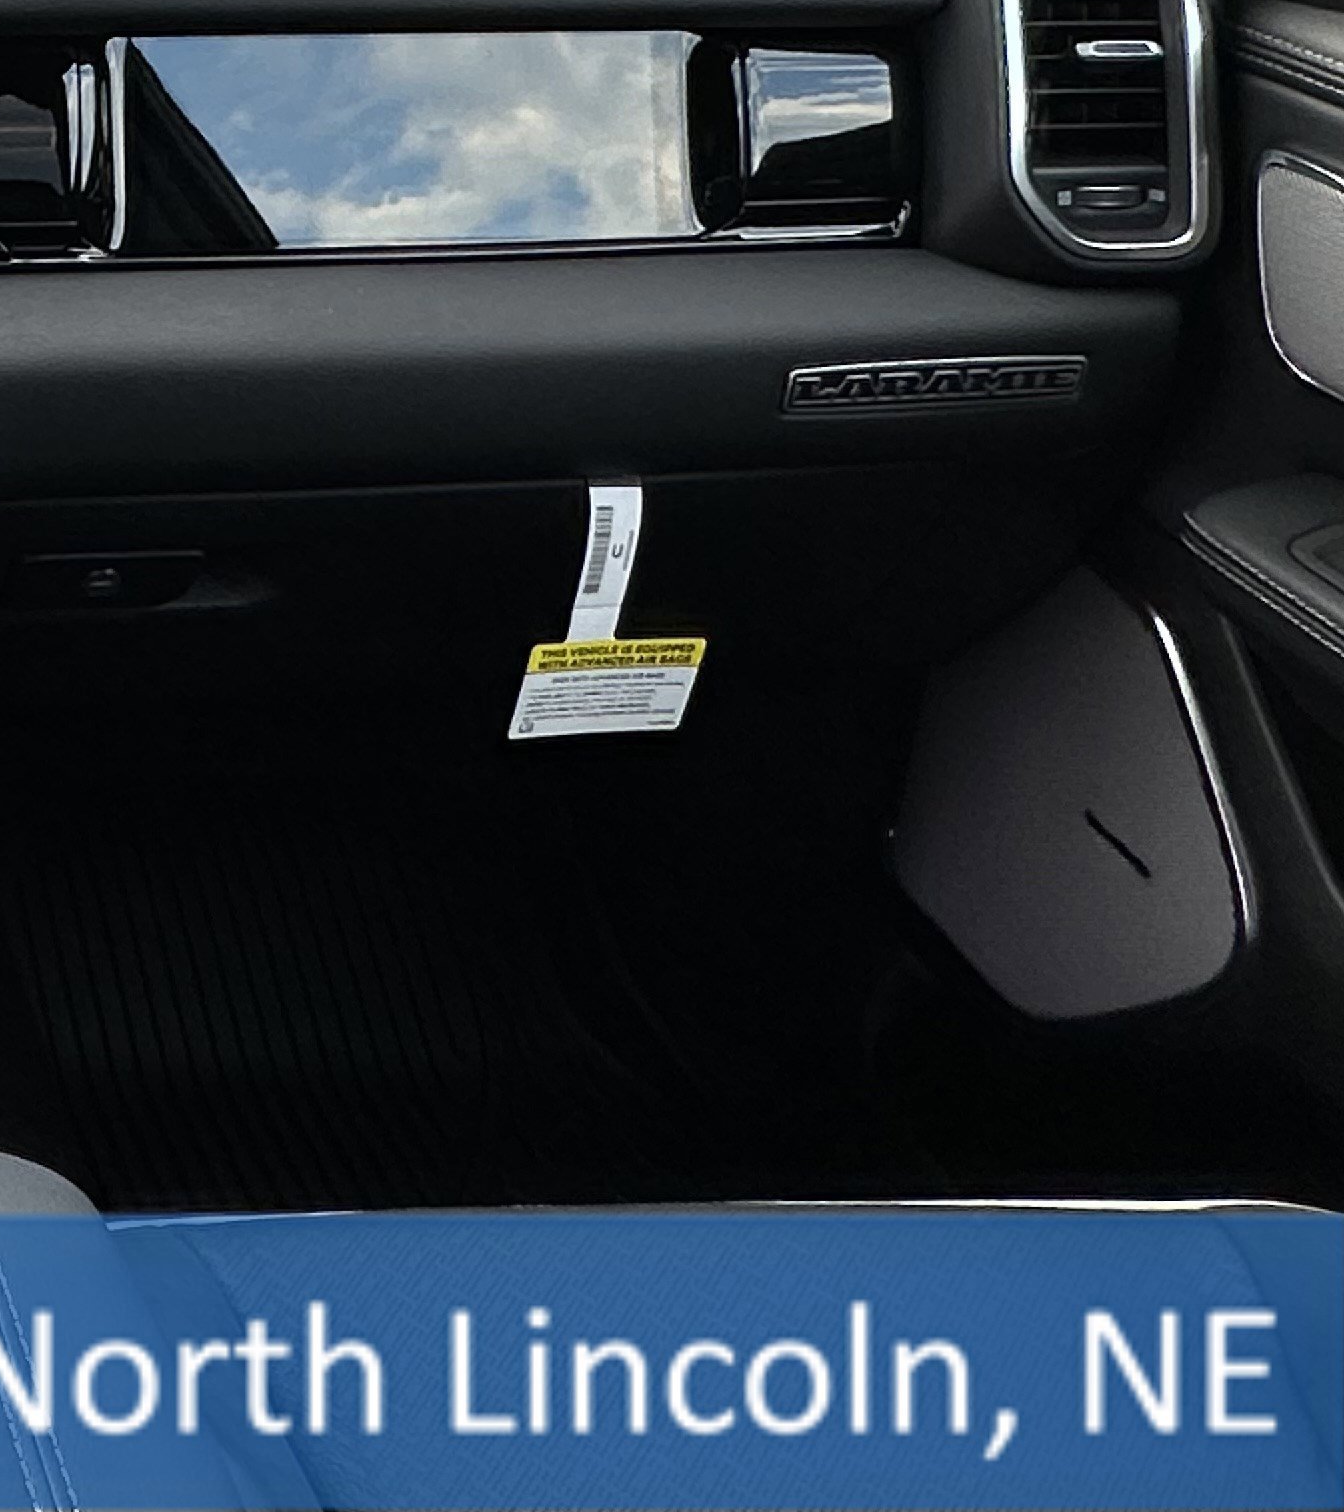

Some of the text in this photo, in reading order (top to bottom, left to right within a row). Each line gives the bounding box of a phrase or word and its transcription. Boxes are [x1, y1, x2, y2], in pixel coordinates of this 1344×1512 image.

[795, 366, 1080, 402] LARAMIE
[570, 645, 617, 657] VEHICLE
[634, 642, 696, 654] EQUIPPED
[570, 655, 636, 668] ADVANCED
[637, 654, 658, 665] AIR
[659, 653, 693, 664] BAGS
